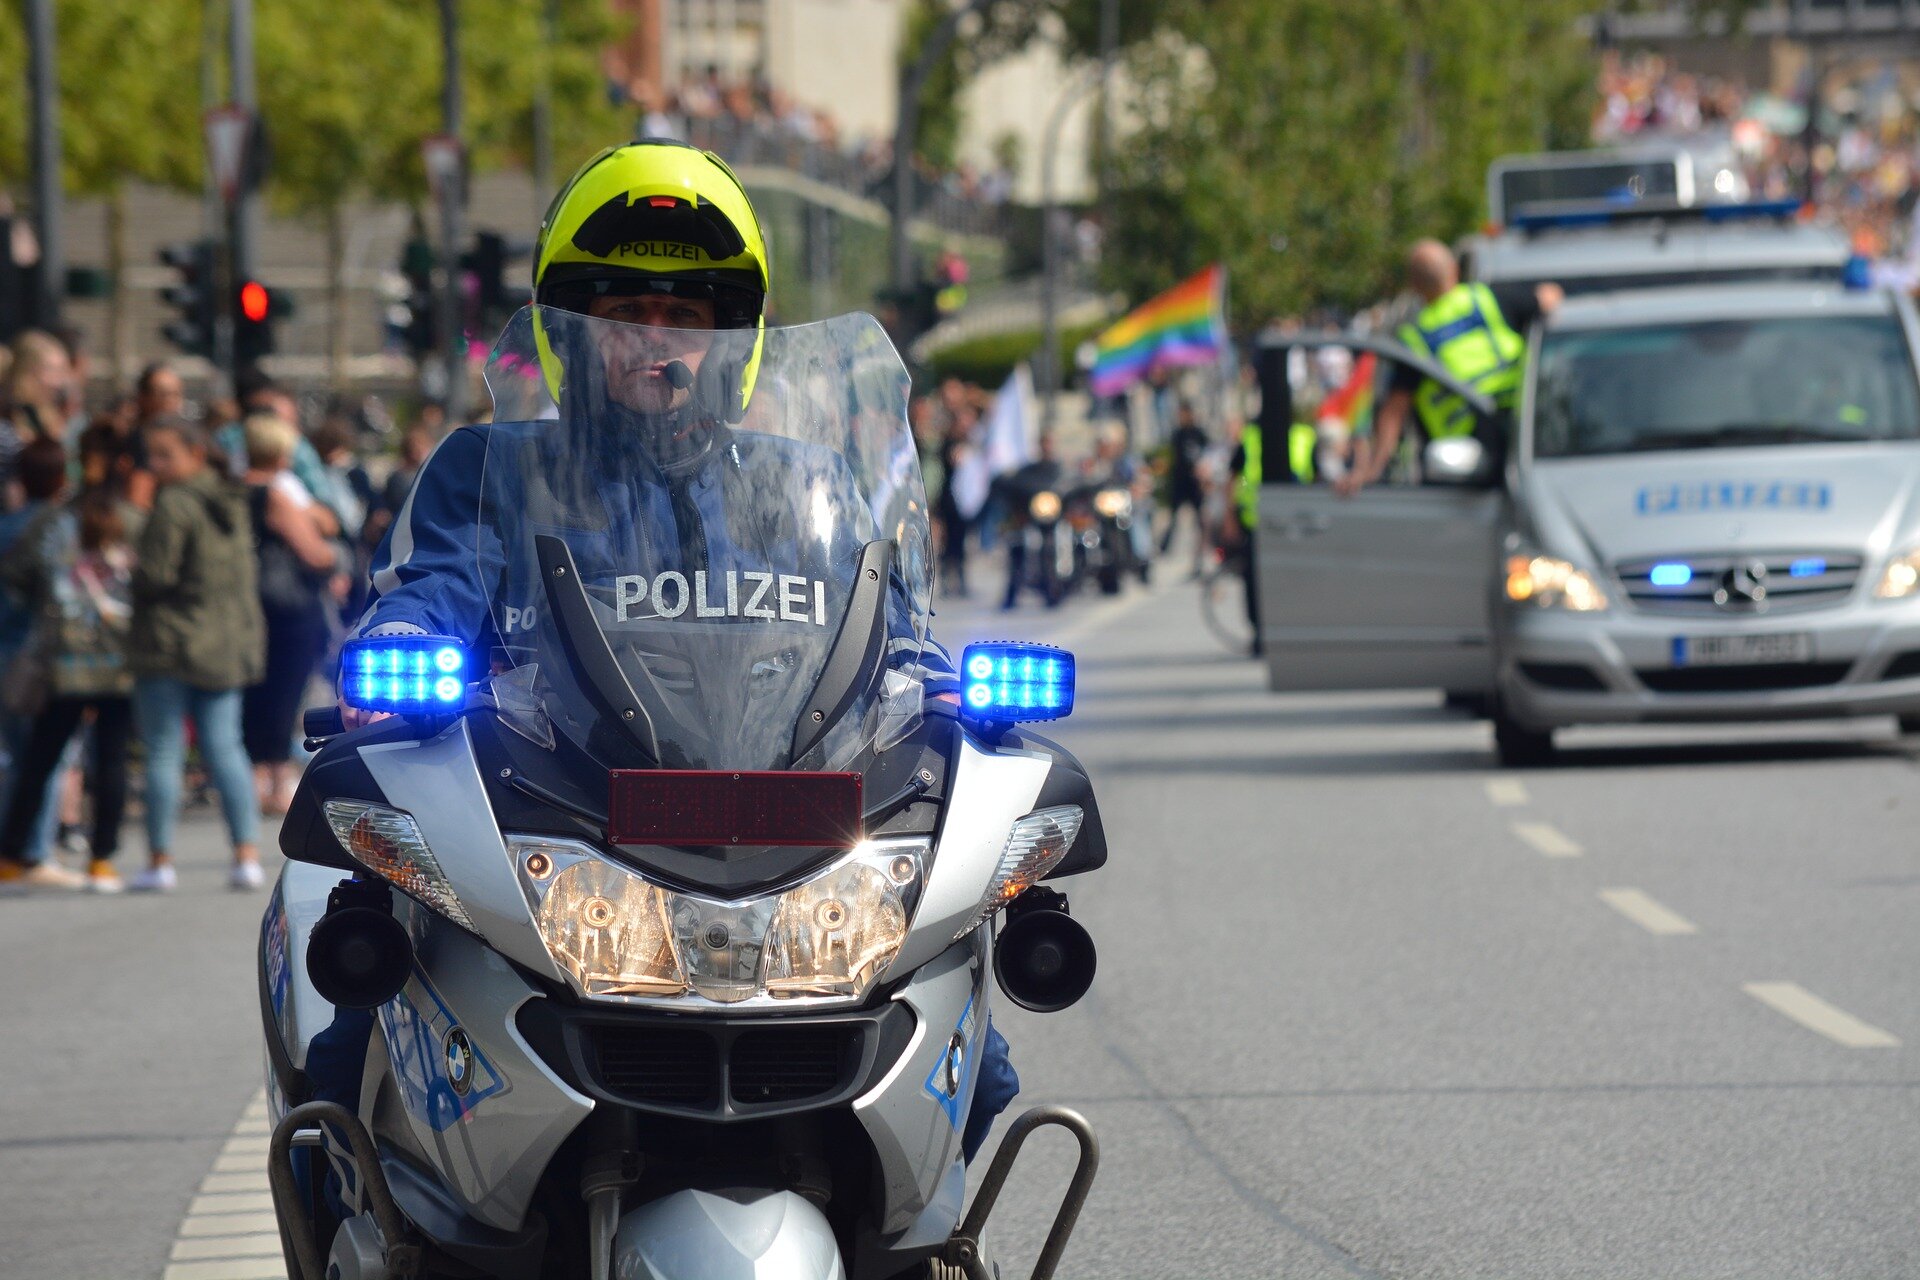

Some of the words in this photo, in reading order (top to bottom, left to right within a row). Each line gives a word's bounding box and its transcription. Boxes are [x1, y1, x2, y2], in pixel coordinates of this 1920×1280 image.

[619, 241, 699, 261] POLIZEI
[615, 571, 825, 626] POLIZEI
[505, 605, 537, 633] PO
